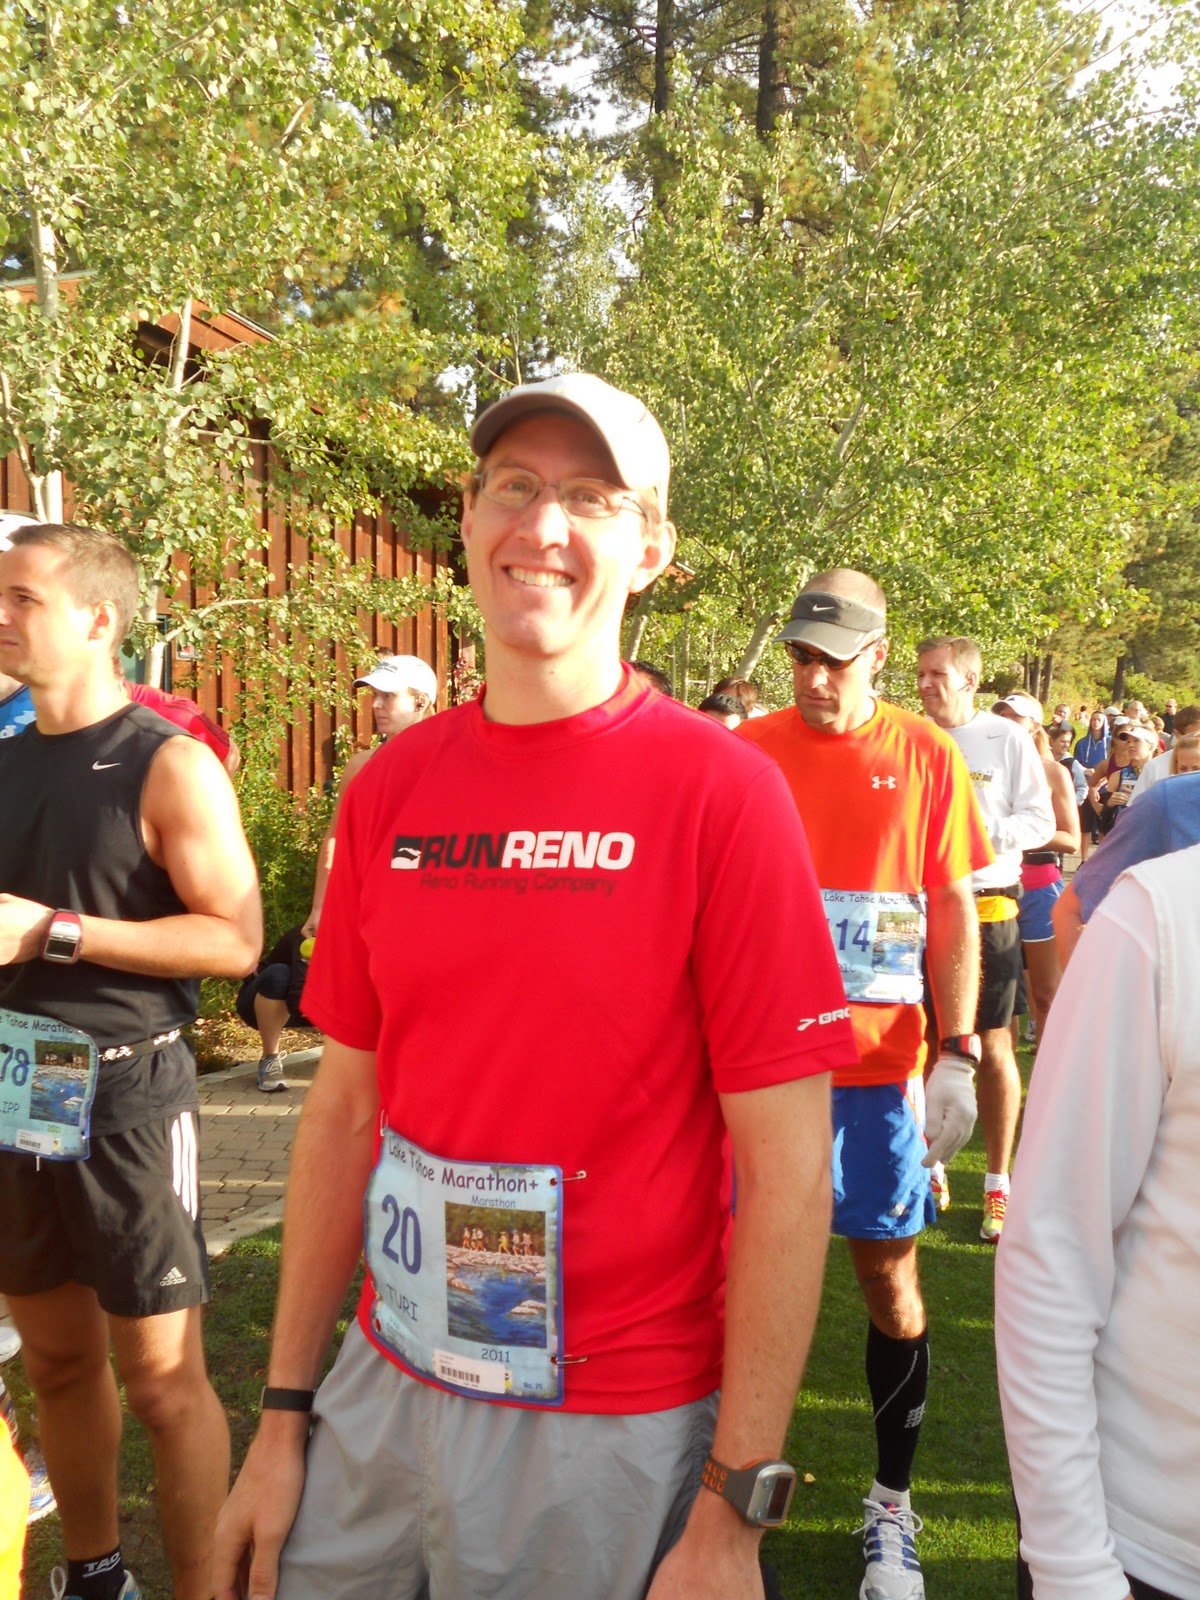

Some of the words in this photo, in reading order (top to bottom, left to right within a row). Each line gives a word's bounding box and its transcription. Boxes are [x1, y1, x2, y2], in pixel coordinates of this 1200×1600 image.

[421, 831, 635, 870] RUNRENO
[420, 873, 457, 888] Reno
[464, 872, 528, 894] Running
[533, 872, 617, 896] Company
[823, 892, 845, 903] Lake
[849, 893, 875, 904] Tahoe
[827, 918, 870, 952] 14
[6, 1014, 29, 1029] Tahoe
[389, 1135, 406, 1164] Lake
[409, 1150, 435, 1181] Tahoe
[441, 1167, 539, 1193] Marathon+
[471, 1194, 516, 1209] Marathon
[381, 1194, 422, 1275] 20
[386, 1284, 419, 1322] TURI
[481, 1348, 511, 1363] 2011
